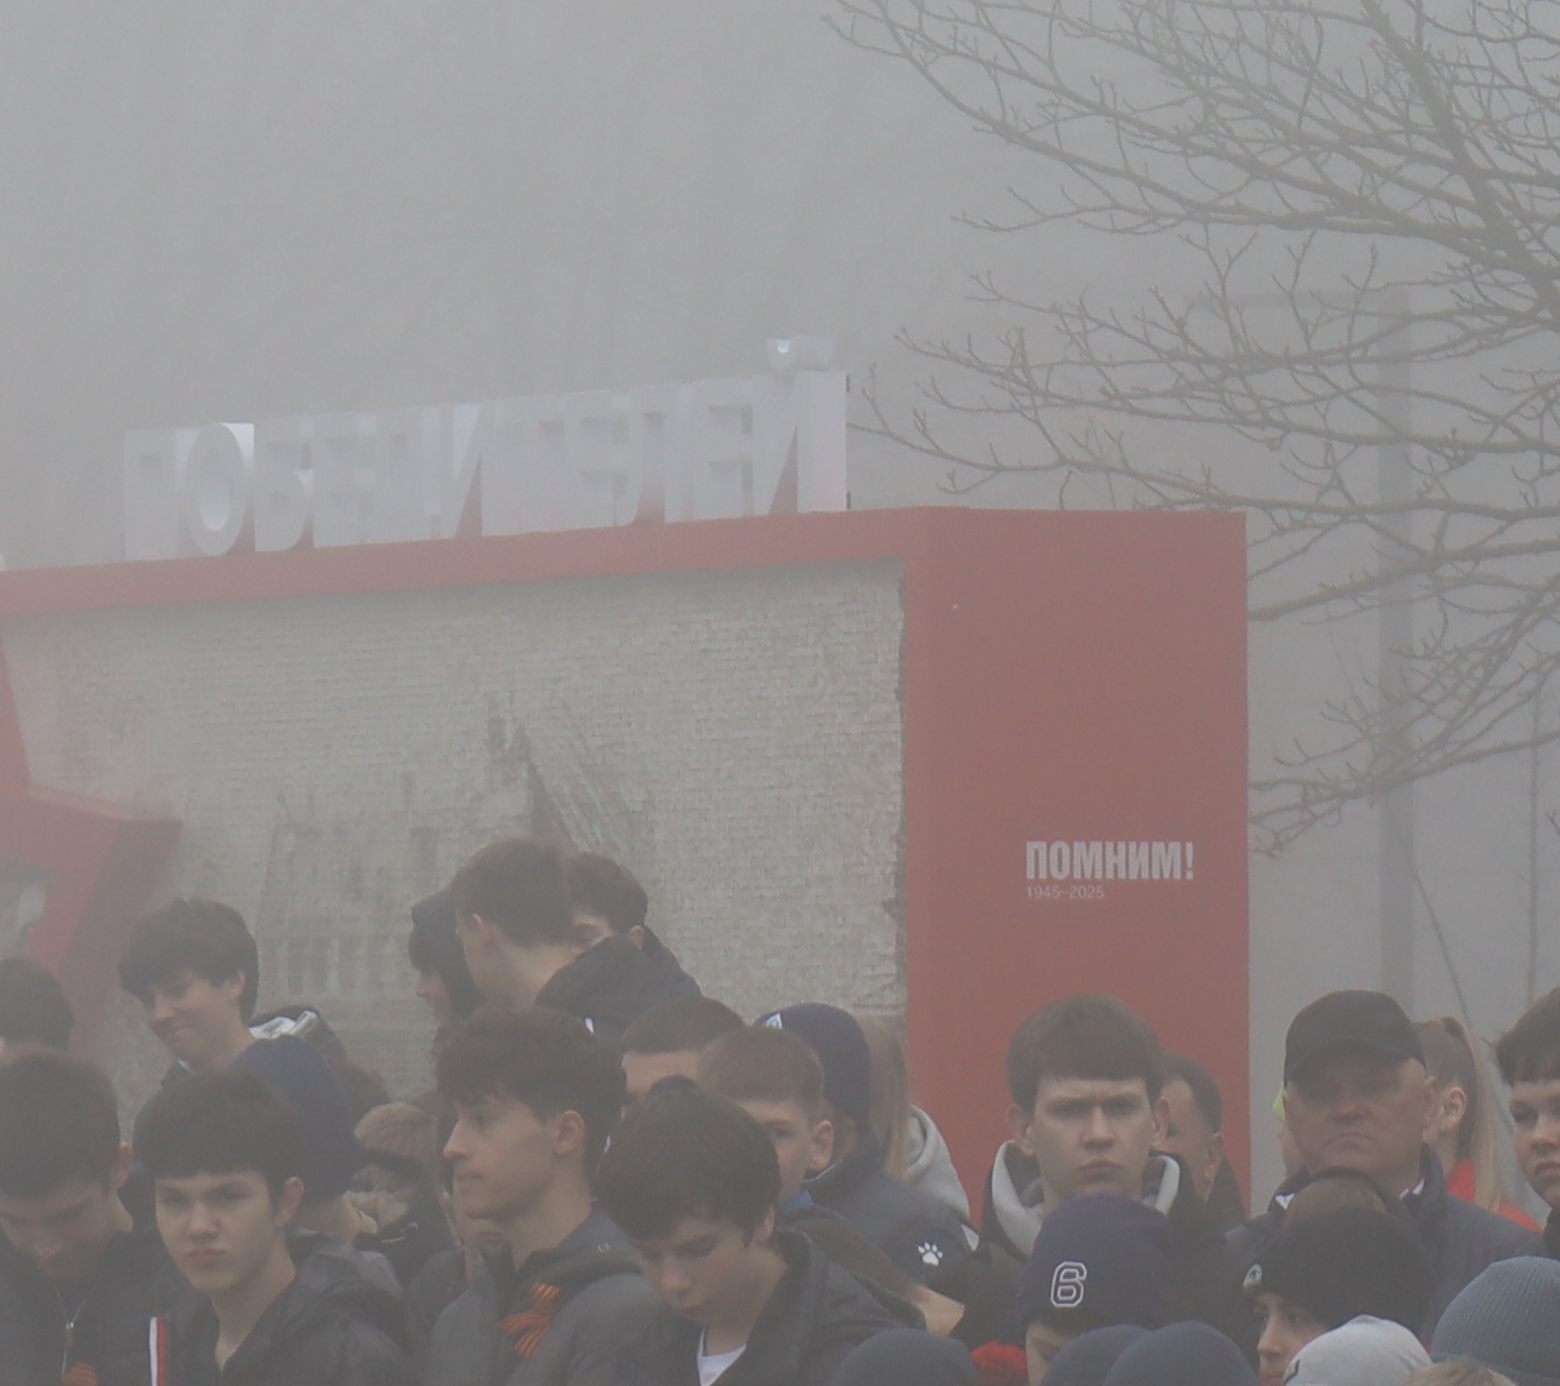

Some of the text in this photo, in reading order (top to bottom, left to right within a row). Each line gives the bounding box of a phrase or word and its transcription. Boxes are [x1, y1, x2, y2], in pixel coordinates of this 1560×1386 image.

[123, 337, 847, 561] ПОБЕДИТЕЛЕЙ
[1026, 840, 1194, 880] ПОМНИМ!
[1051, 1261, 1088, 1307] 6
